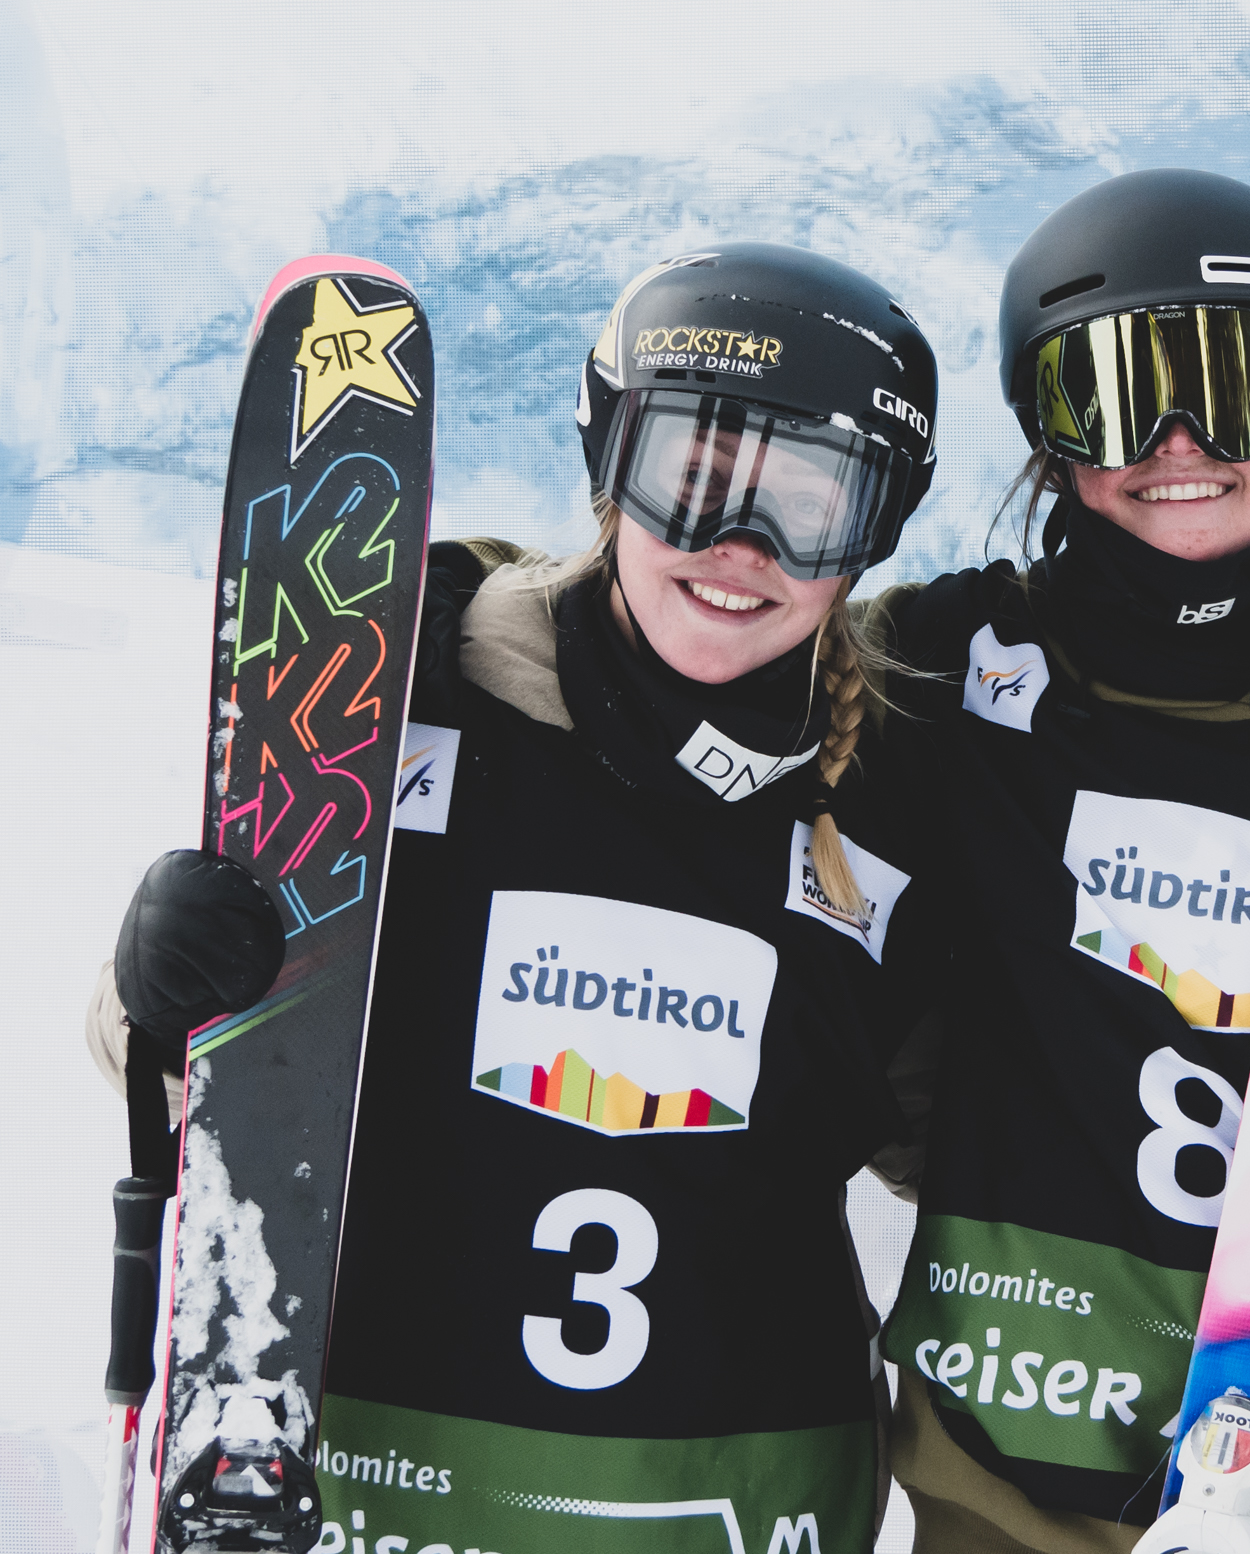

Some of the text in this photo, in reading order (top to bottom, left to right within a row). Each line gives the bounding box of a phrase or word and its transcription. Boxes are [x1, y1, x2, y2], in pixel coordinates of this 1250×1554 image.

[1153, 311, 1186, 320] DRAGON
[638, 353, 764, 376] ENERGY DRINK
[873, 388, 928, 438] GIRO
[1137, 1046, 1244, 1228] 8
[522, 1188, 658, 1390] 3
[929, 1262, 1094, 1315] Dolomites
[315, 1440, 452, 1494] lomites
